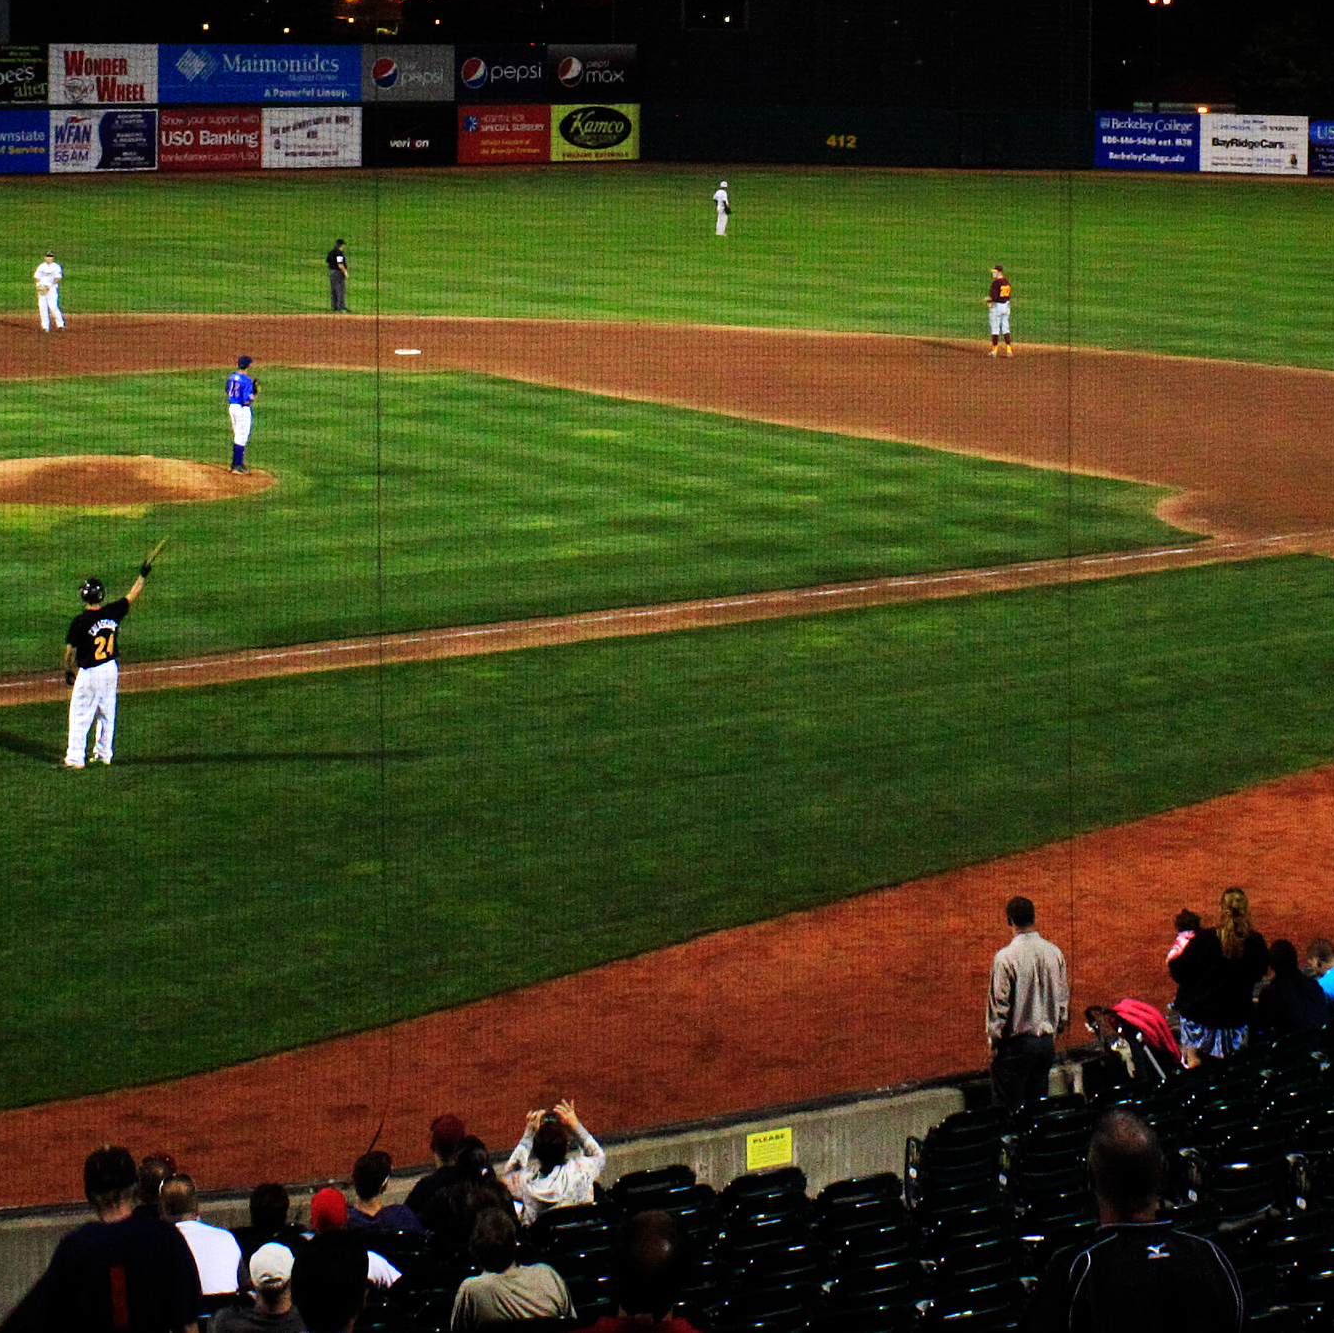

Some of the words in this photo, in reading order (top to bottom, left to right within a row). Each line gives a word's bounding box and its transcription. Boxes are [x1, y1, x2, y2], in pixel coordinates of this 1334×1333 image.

[64, 50, 128, 76] WONDER
[222, 53, 340, 73] Maimonides
[400, 68, 443, 86] pepsi
[490, 62, 542, 84] pepsi
[586, 69, 624, 83] max
[96, 77, 146, 102] WHEEL
[273, 88, 315, 97] Powerful
[161, 116, 184, 125] Show
[188, 118, 205, 126] your
[209, 116, 240, 126] support
[480, 124, 511, 132] SPECIAL
[569, 110, 625, 136] Kamco
[1111, 118, 1153, 133] Berkeley
[1155, 119, 1193, 134] College
[161, 130, 194, 145] USO
[200, 130, 259, 148] Banking
[825, 134, 858, 149] 412
[753, 1132, 785, 1144] PLEASE
